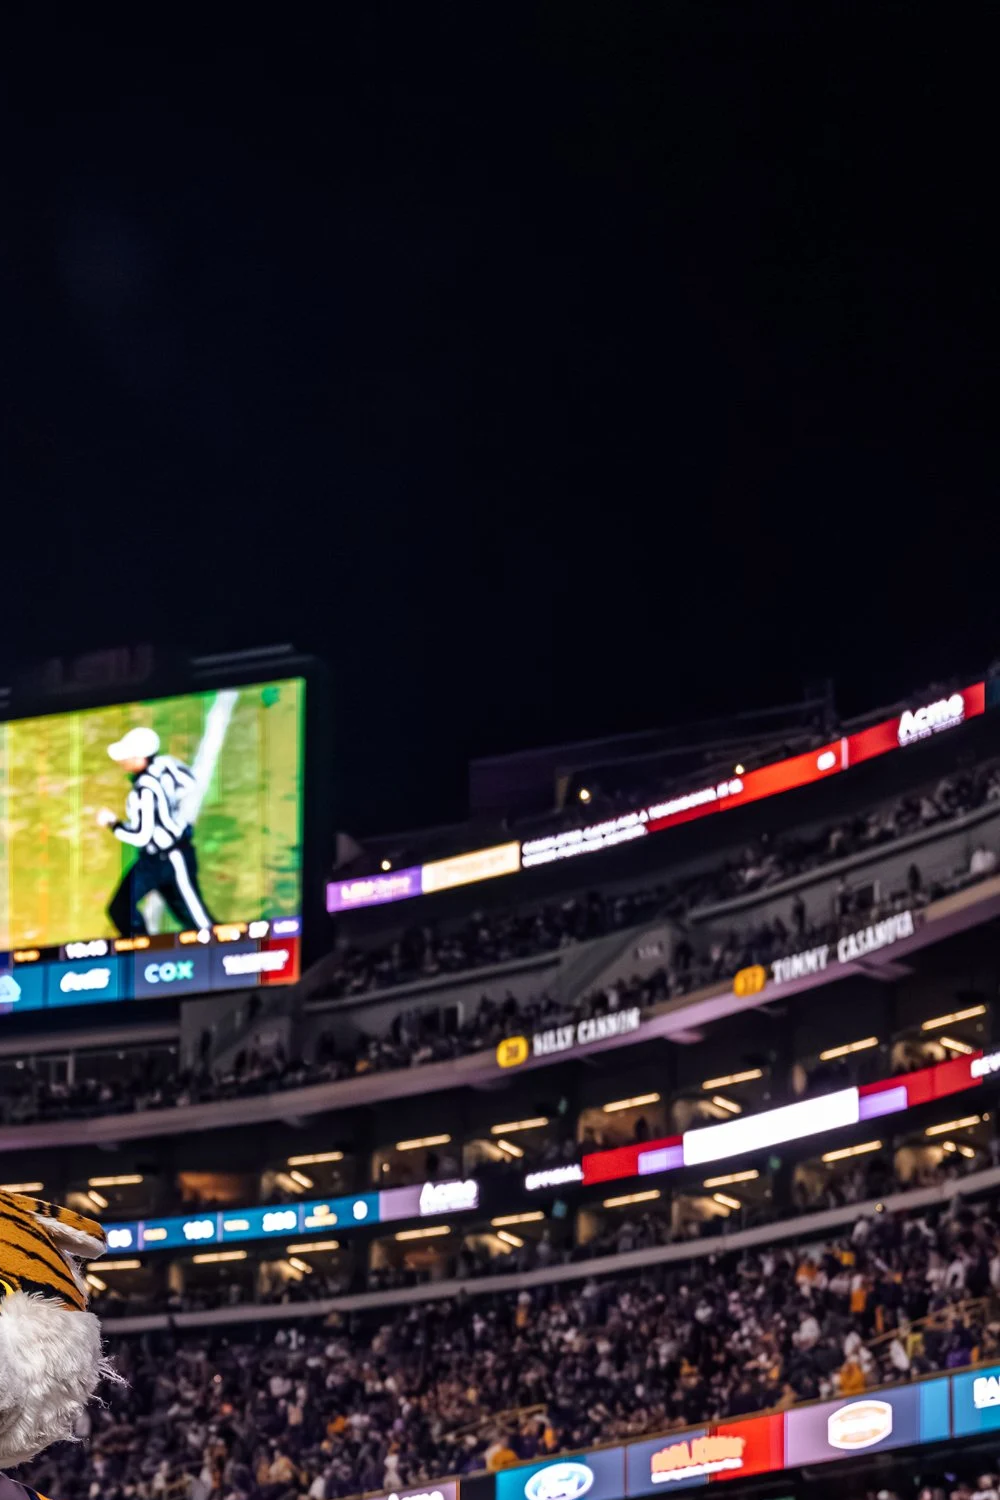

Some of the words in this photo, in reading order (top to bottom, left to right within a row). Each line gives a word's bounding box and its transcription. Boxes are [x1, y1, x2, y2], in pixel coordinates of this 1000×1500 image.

[771, 944, 829, 985] TOMMY
[837, 910, 914, 963] CASANOVA
[533, 1025, 574, 1056] BILLY
[577, 1007, 640, 1044] CANNON
